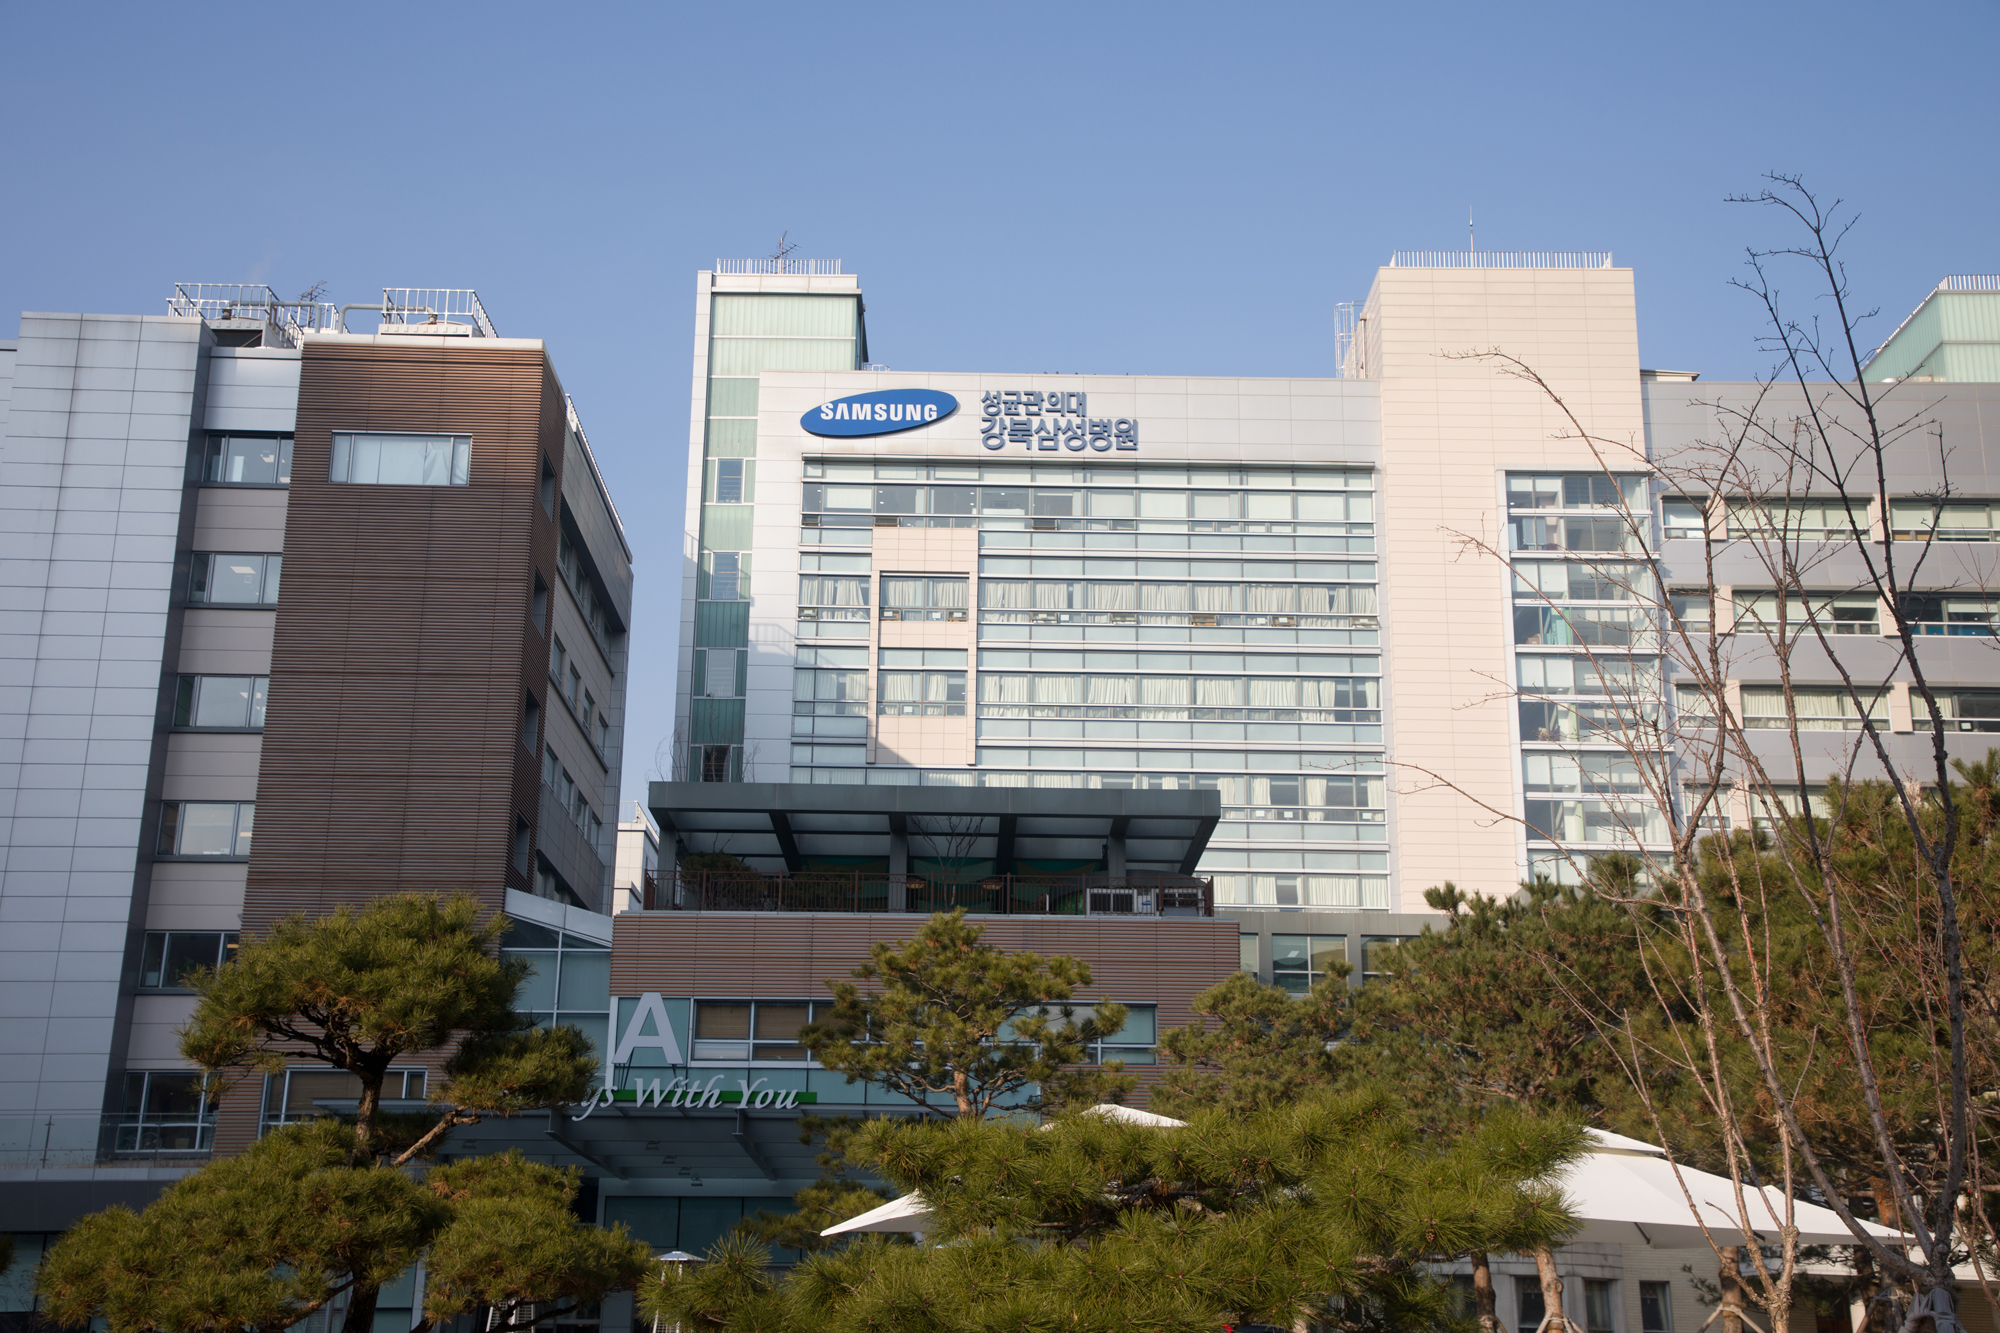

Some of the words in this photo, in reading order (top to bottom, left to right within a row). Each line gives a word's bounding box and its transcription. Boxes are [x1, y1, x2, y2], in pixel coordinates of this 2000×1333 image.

[820, 403, 938, 421] SAMSUNG
[980, 391, 1087, 417] 성균관의대
[980, 418, 1139, 451] 강북삼성병원
[611, 992, 684, 1064] A
[634, 1074, 725, 1109] With
[736, 1077, 799, 1110] You
